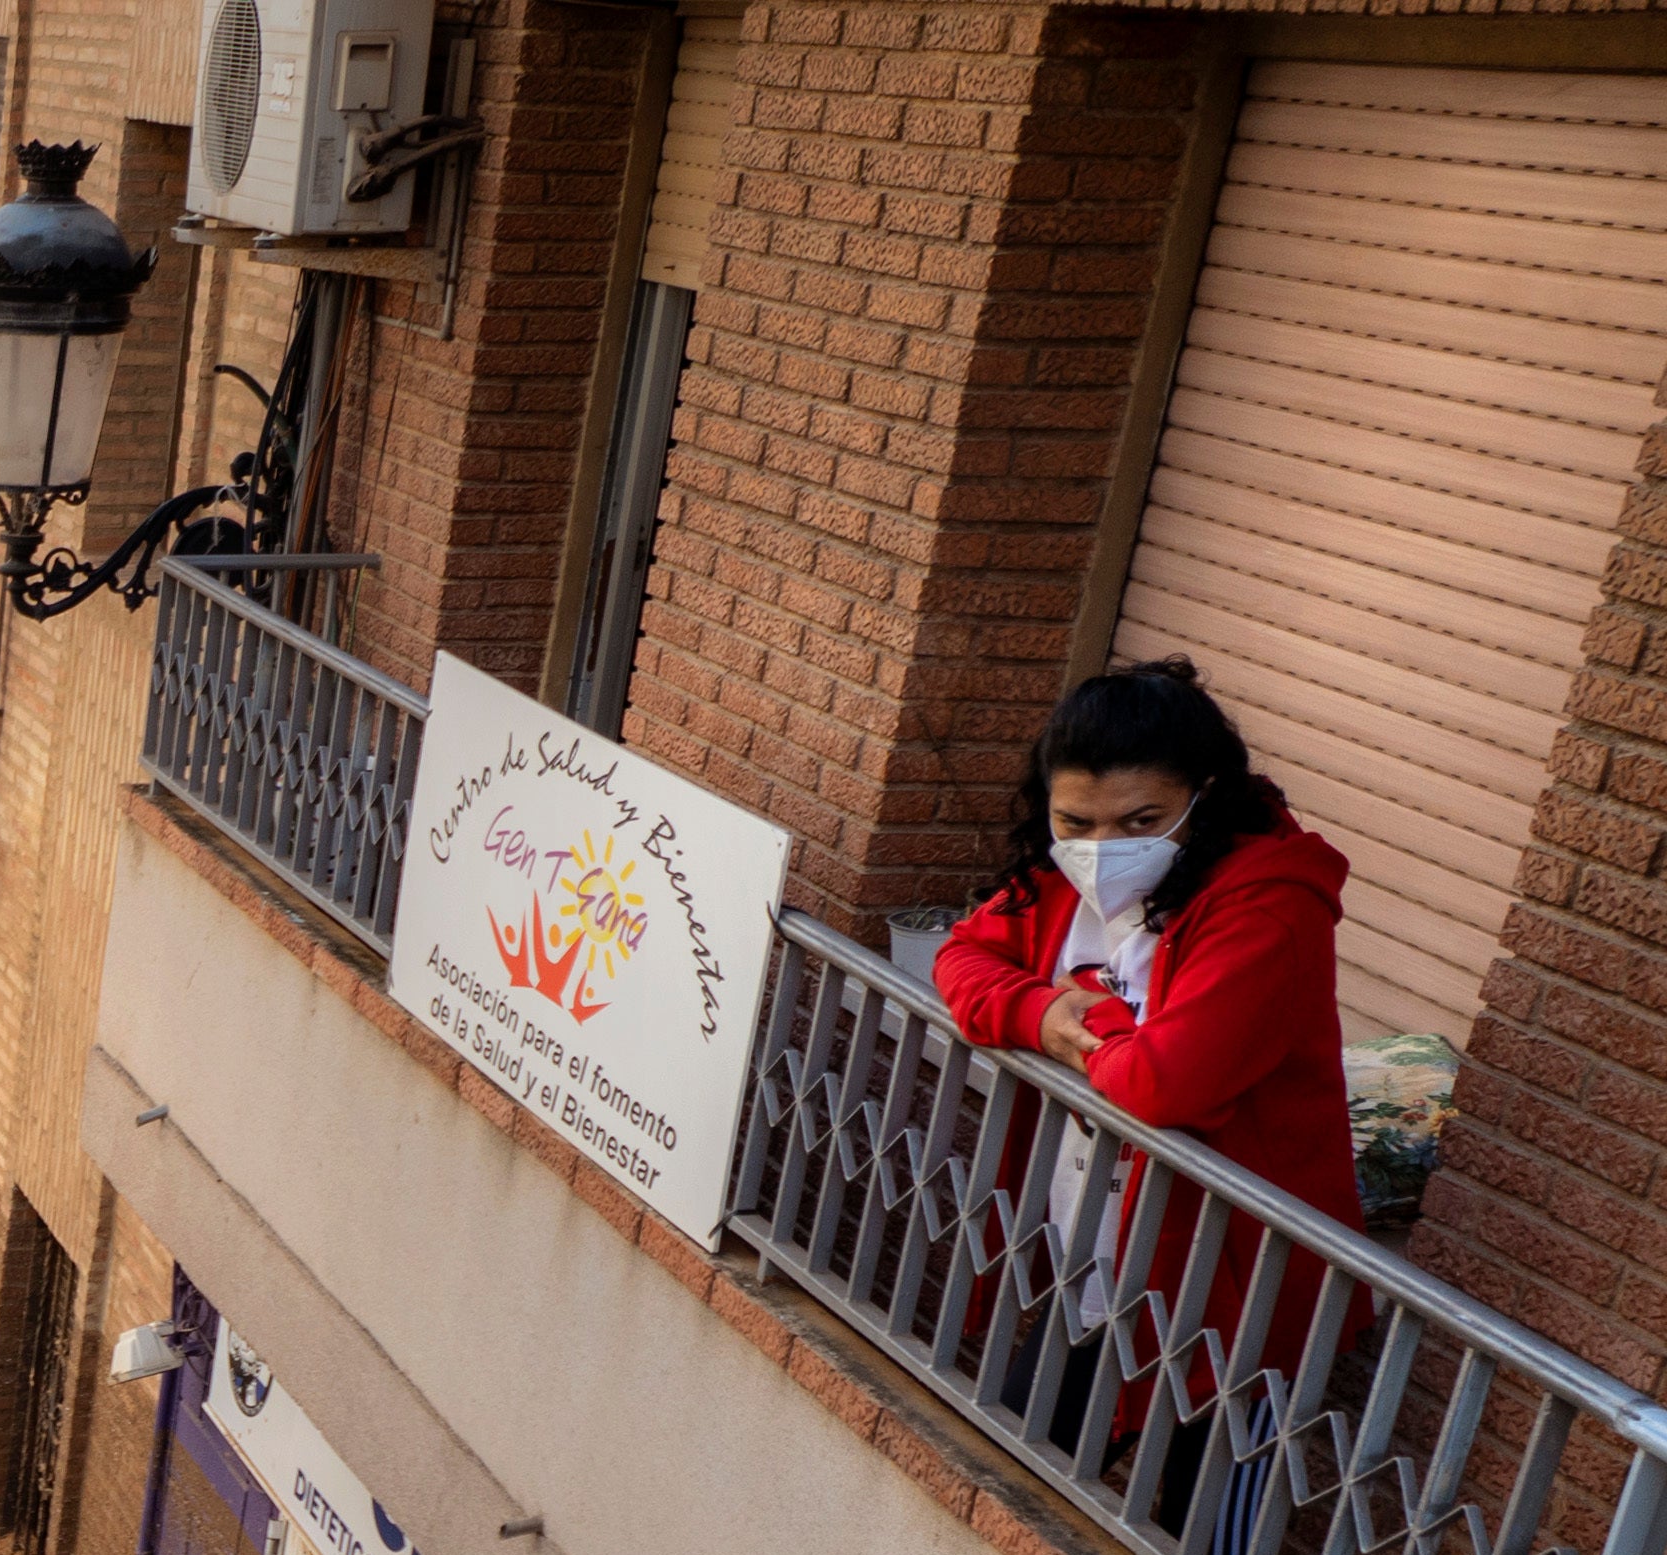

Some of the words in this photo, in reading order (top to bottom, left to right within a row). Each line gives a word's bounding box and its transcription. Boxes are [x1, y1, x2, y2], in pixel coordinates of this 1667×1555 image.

[430, 766, 492, 864] Centro
[500, 731, 529, 777] de
[537, 731, 618, 796] Salud
[613, 799, 640, 829] y
[641, 814, 725, 1044] Bienestar
[427, 943, 520, 1033] Asociación
[520, 1019, 565, 1066] para
[569, 1056, 589, 1085] el
[589, 1065, 677, 1151] fomento
[430, 994, 451, 1026] de
[452, 1008, 468, 1042] la
[472, 1024, 524, 1084] Salud
[522, 1070, 538, 1100] y
[541, 1084, 560, 1113] el
[560, 1094, 661, 1190] Bienestar
